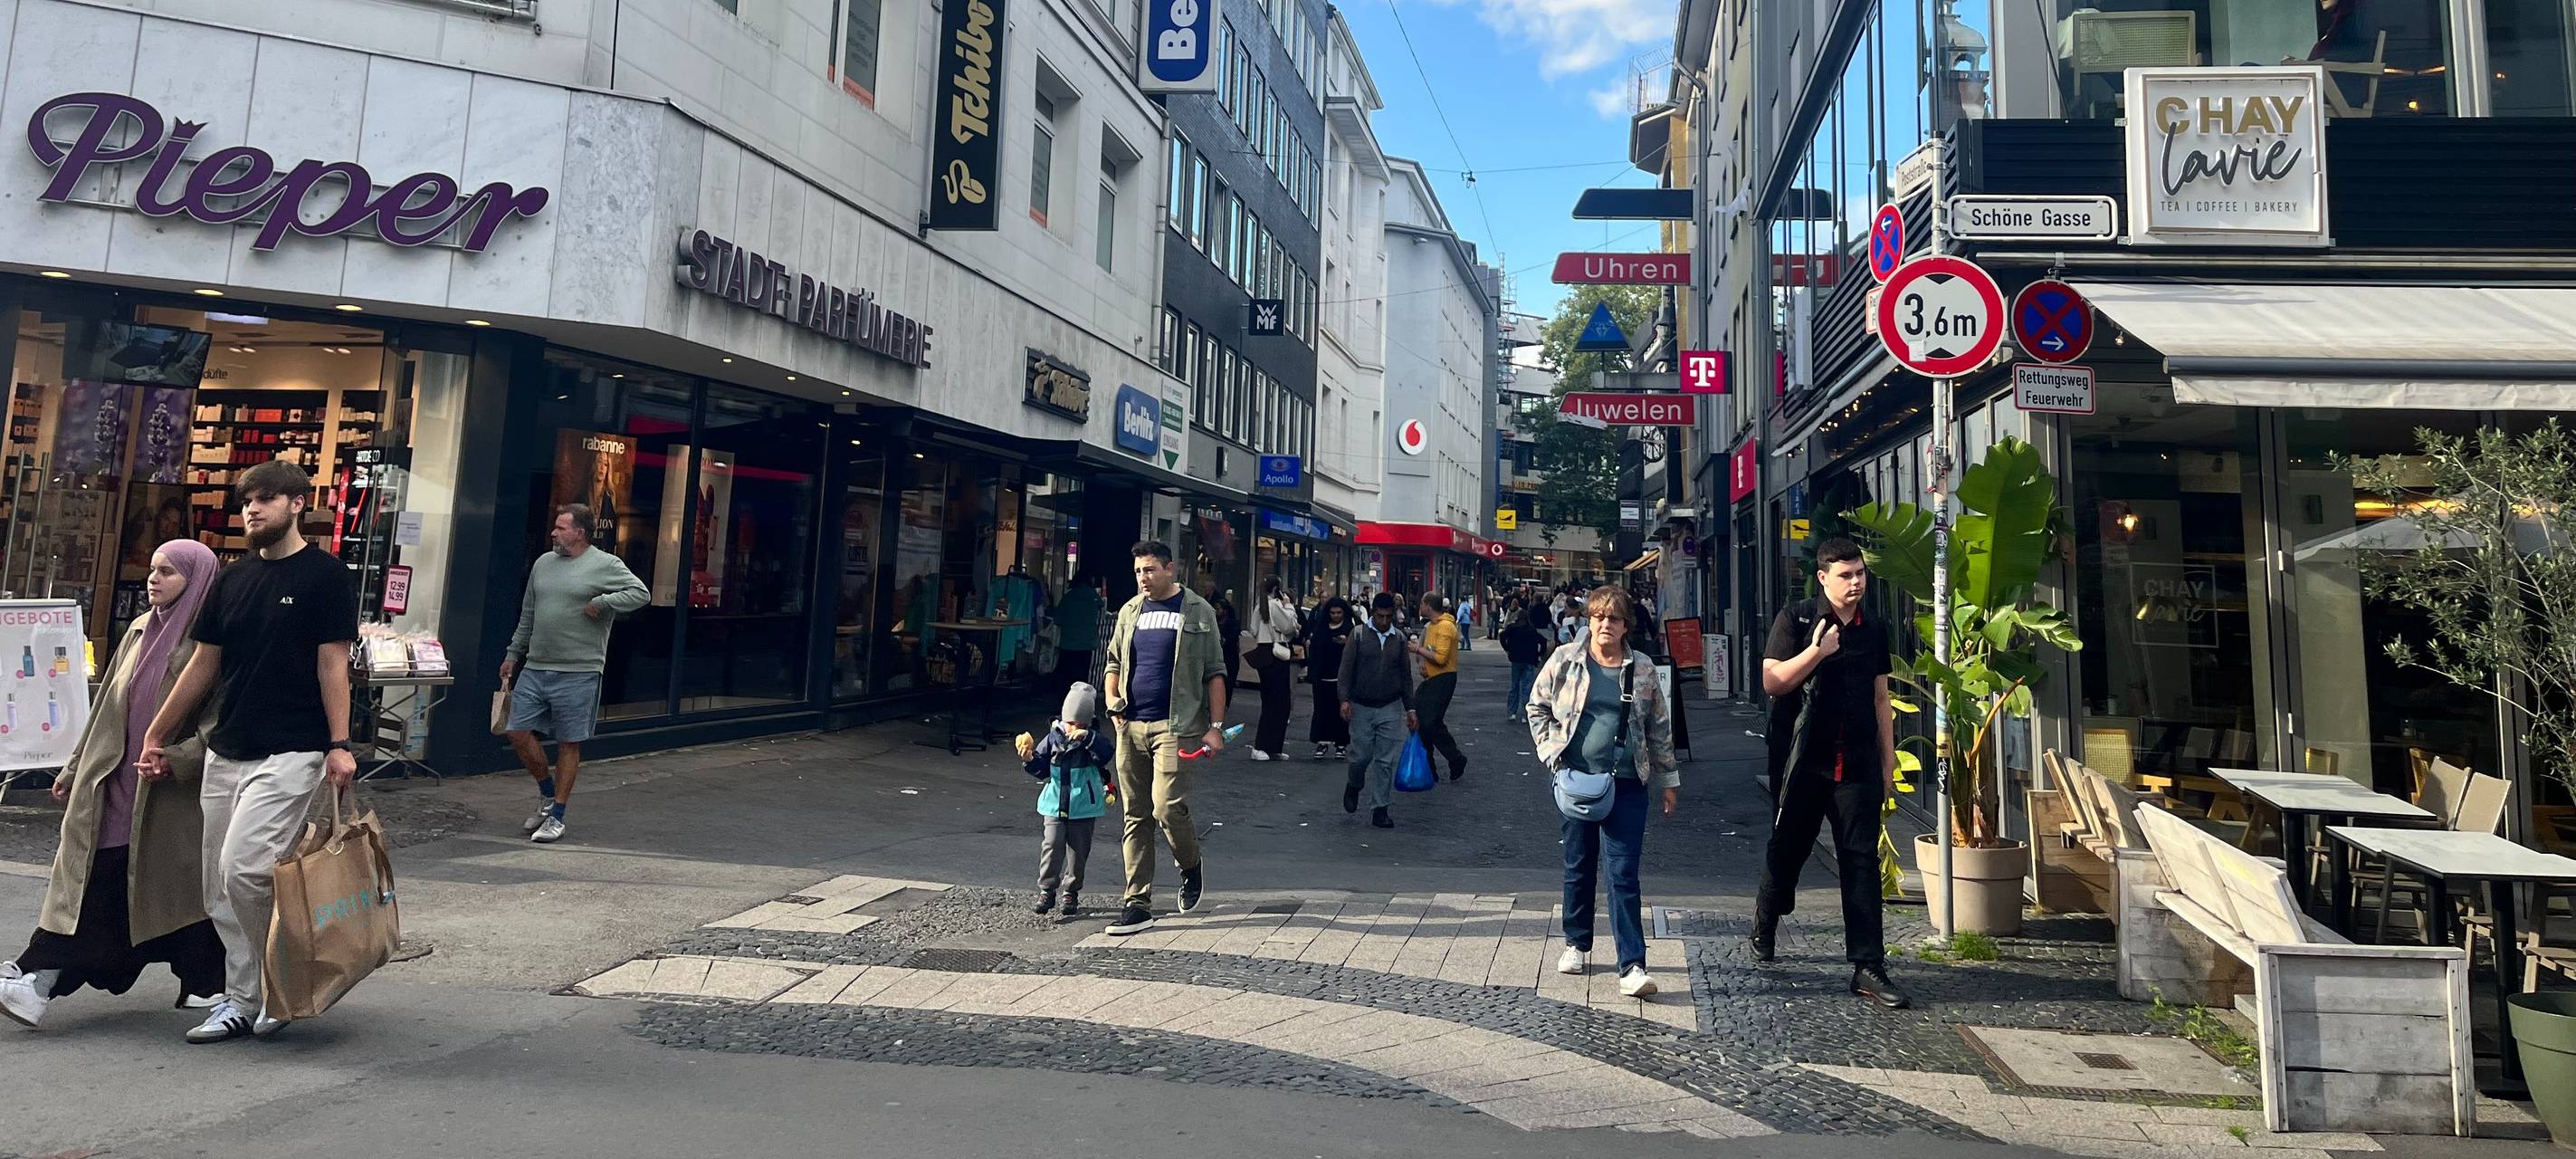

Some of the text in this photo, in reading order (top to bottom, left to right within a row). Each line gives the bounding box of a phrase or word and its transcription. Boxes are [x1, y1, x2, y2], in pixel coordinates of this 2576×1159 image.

[951, 0, 995, 144] Tchibo
[2156, 96, 2304, 135] CHAY
[26, 91, 549, 253] Pieper
[1971, 207, 2091, 226] Schöne Gasse
[2161, 201, 2298, 213] TEA COFFEE BAKERY
[1584, 257, 1678, 279] Uhren
[2018, 369, 2089, 390] Rettungsweg
[2025, 390, 2085, 407] Feuerwehr
[1570, 398, 1682, 421] Juwelen
[1123, 401, 1154, 442] Berlitz
[582, 436, 625, 454] rabanne
[1264, 474, 1294, 484] Apollo
[2143, 579, 2205, 599] CHAY
[0, 611, 72, 625] GEBOTE
[1136, 610, 1180, 630] UMA
